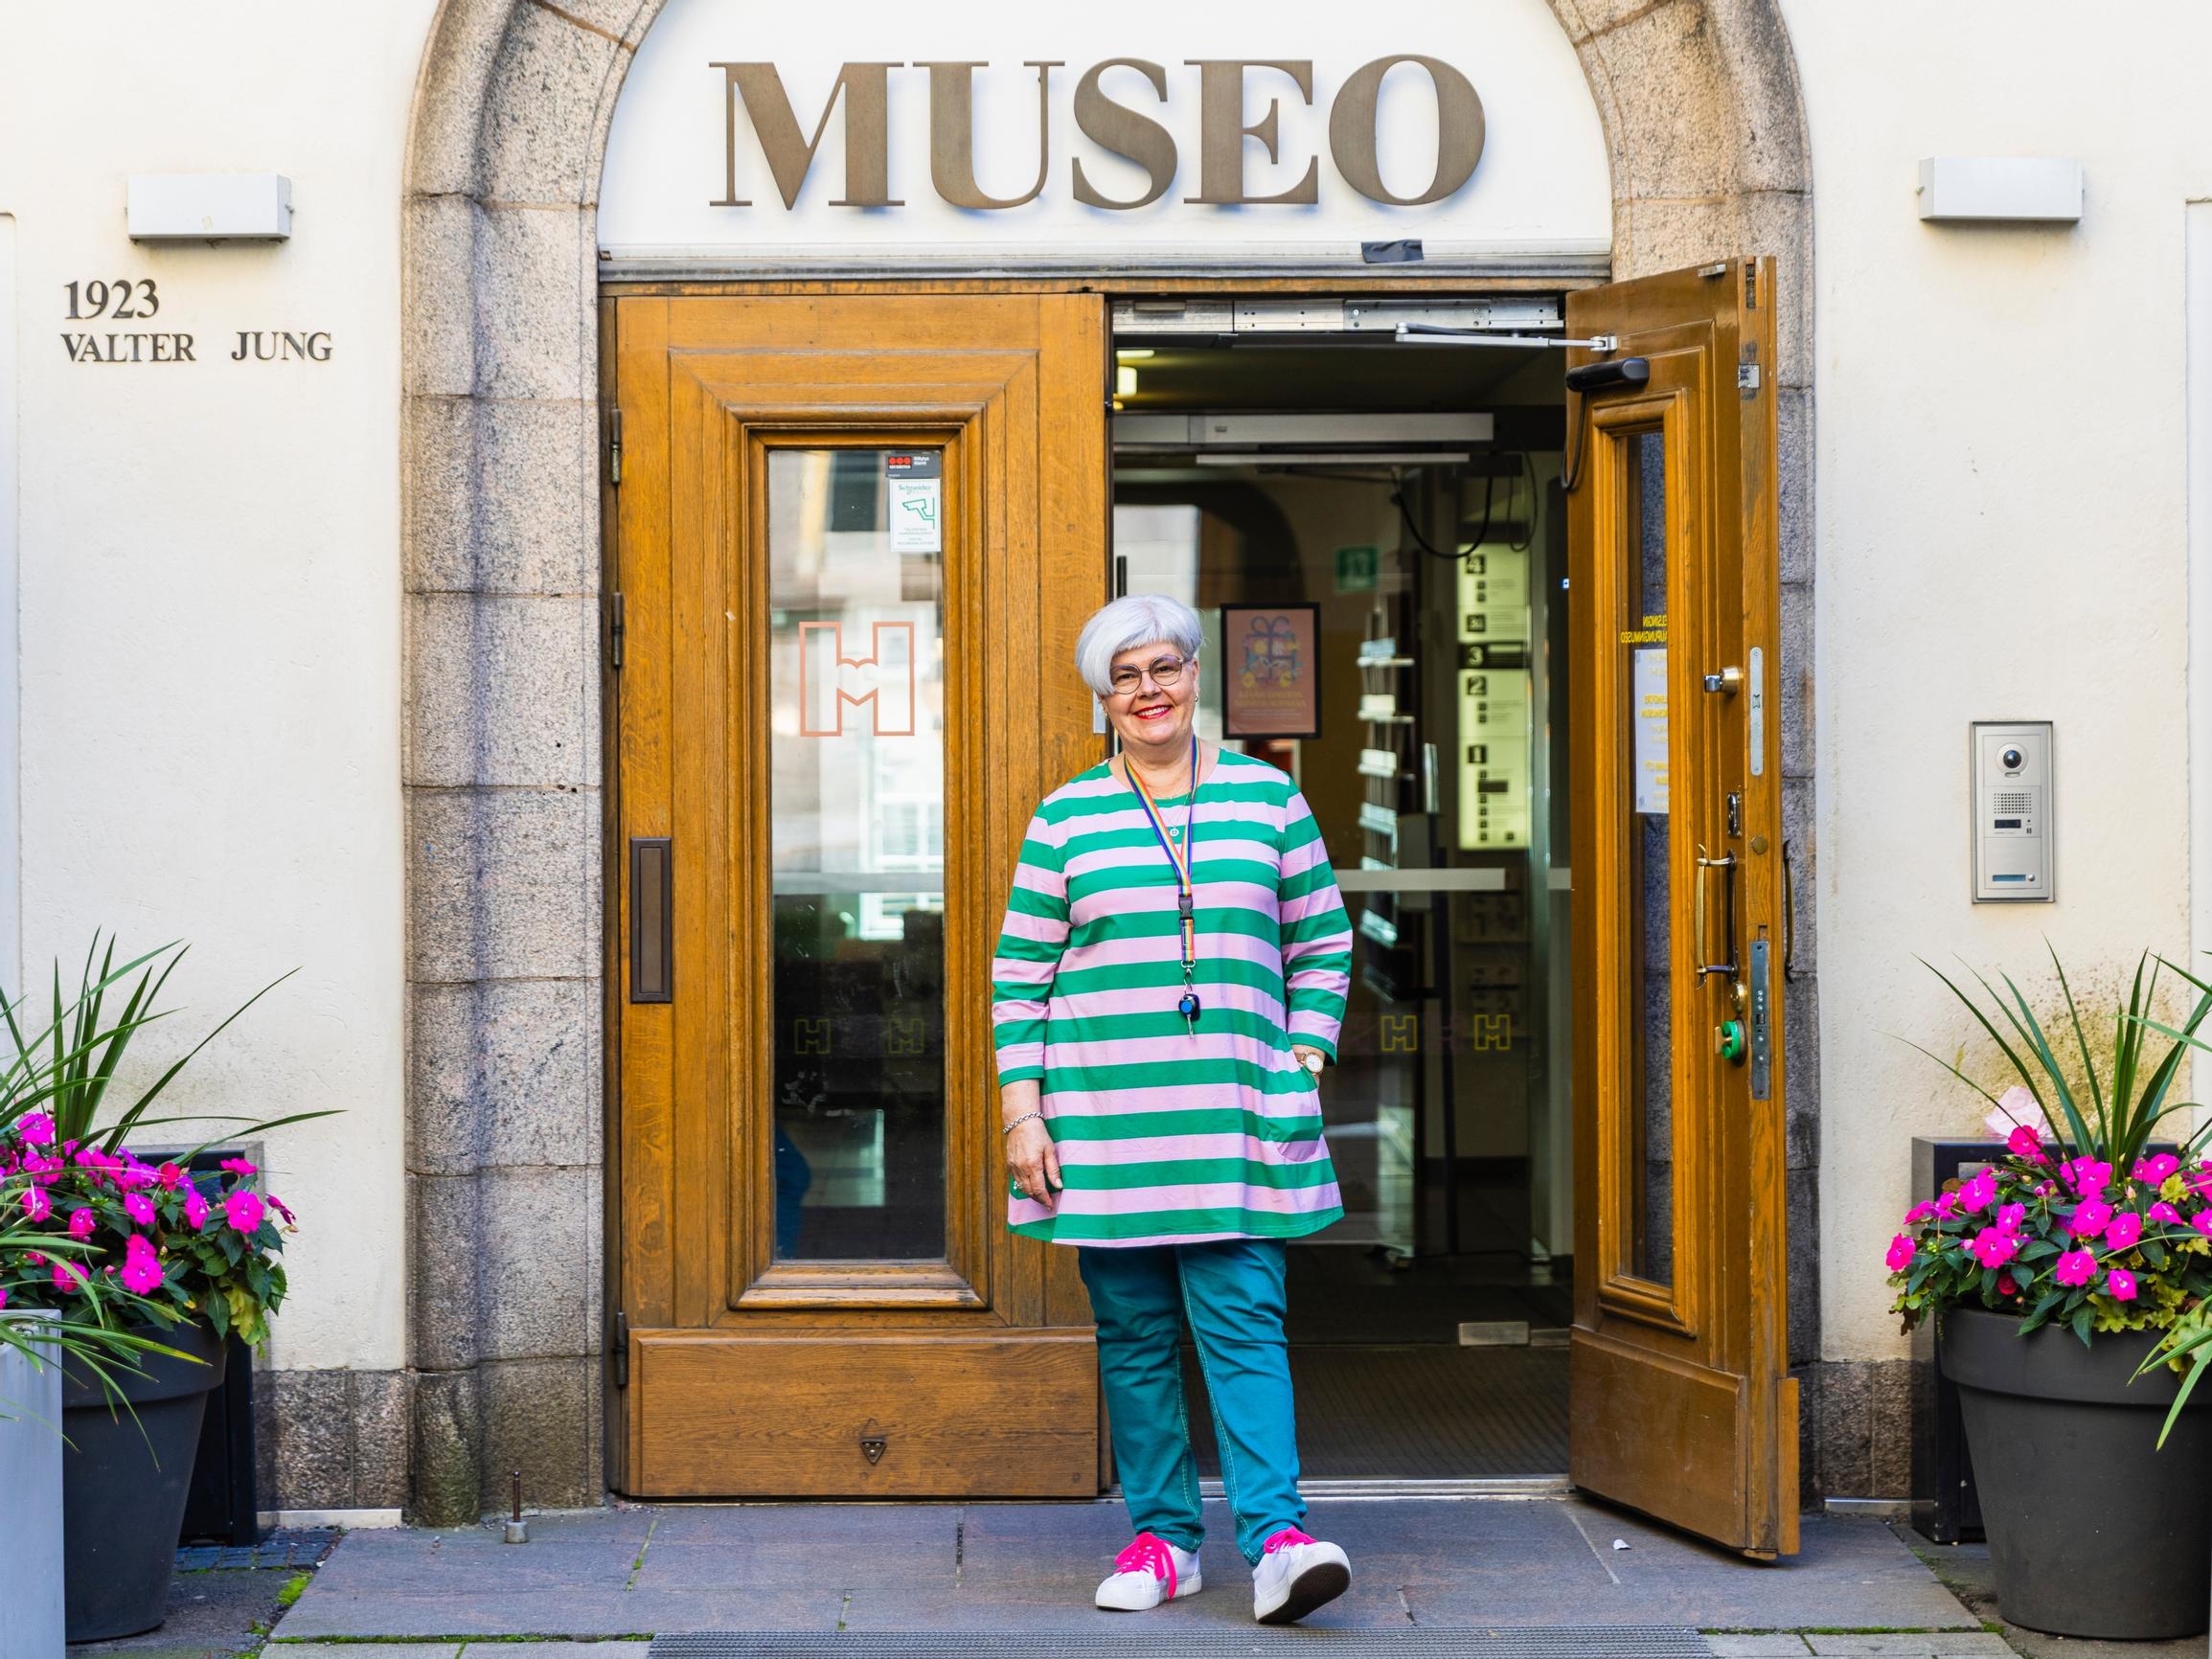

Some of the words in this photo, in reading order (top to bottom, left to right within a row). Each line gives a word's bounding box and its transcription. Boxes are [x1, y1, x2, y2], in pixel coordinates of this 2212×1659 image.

[709, 54, 1486, 211] MUSEO
[63, 279, 160, 320] 1923
[61, 332, 196, 363] VALTER
[231, 330, 333, 362] JUNG
[1468, 646, 1483, 668] 3
[1469, 676, 1485, 694] 2
